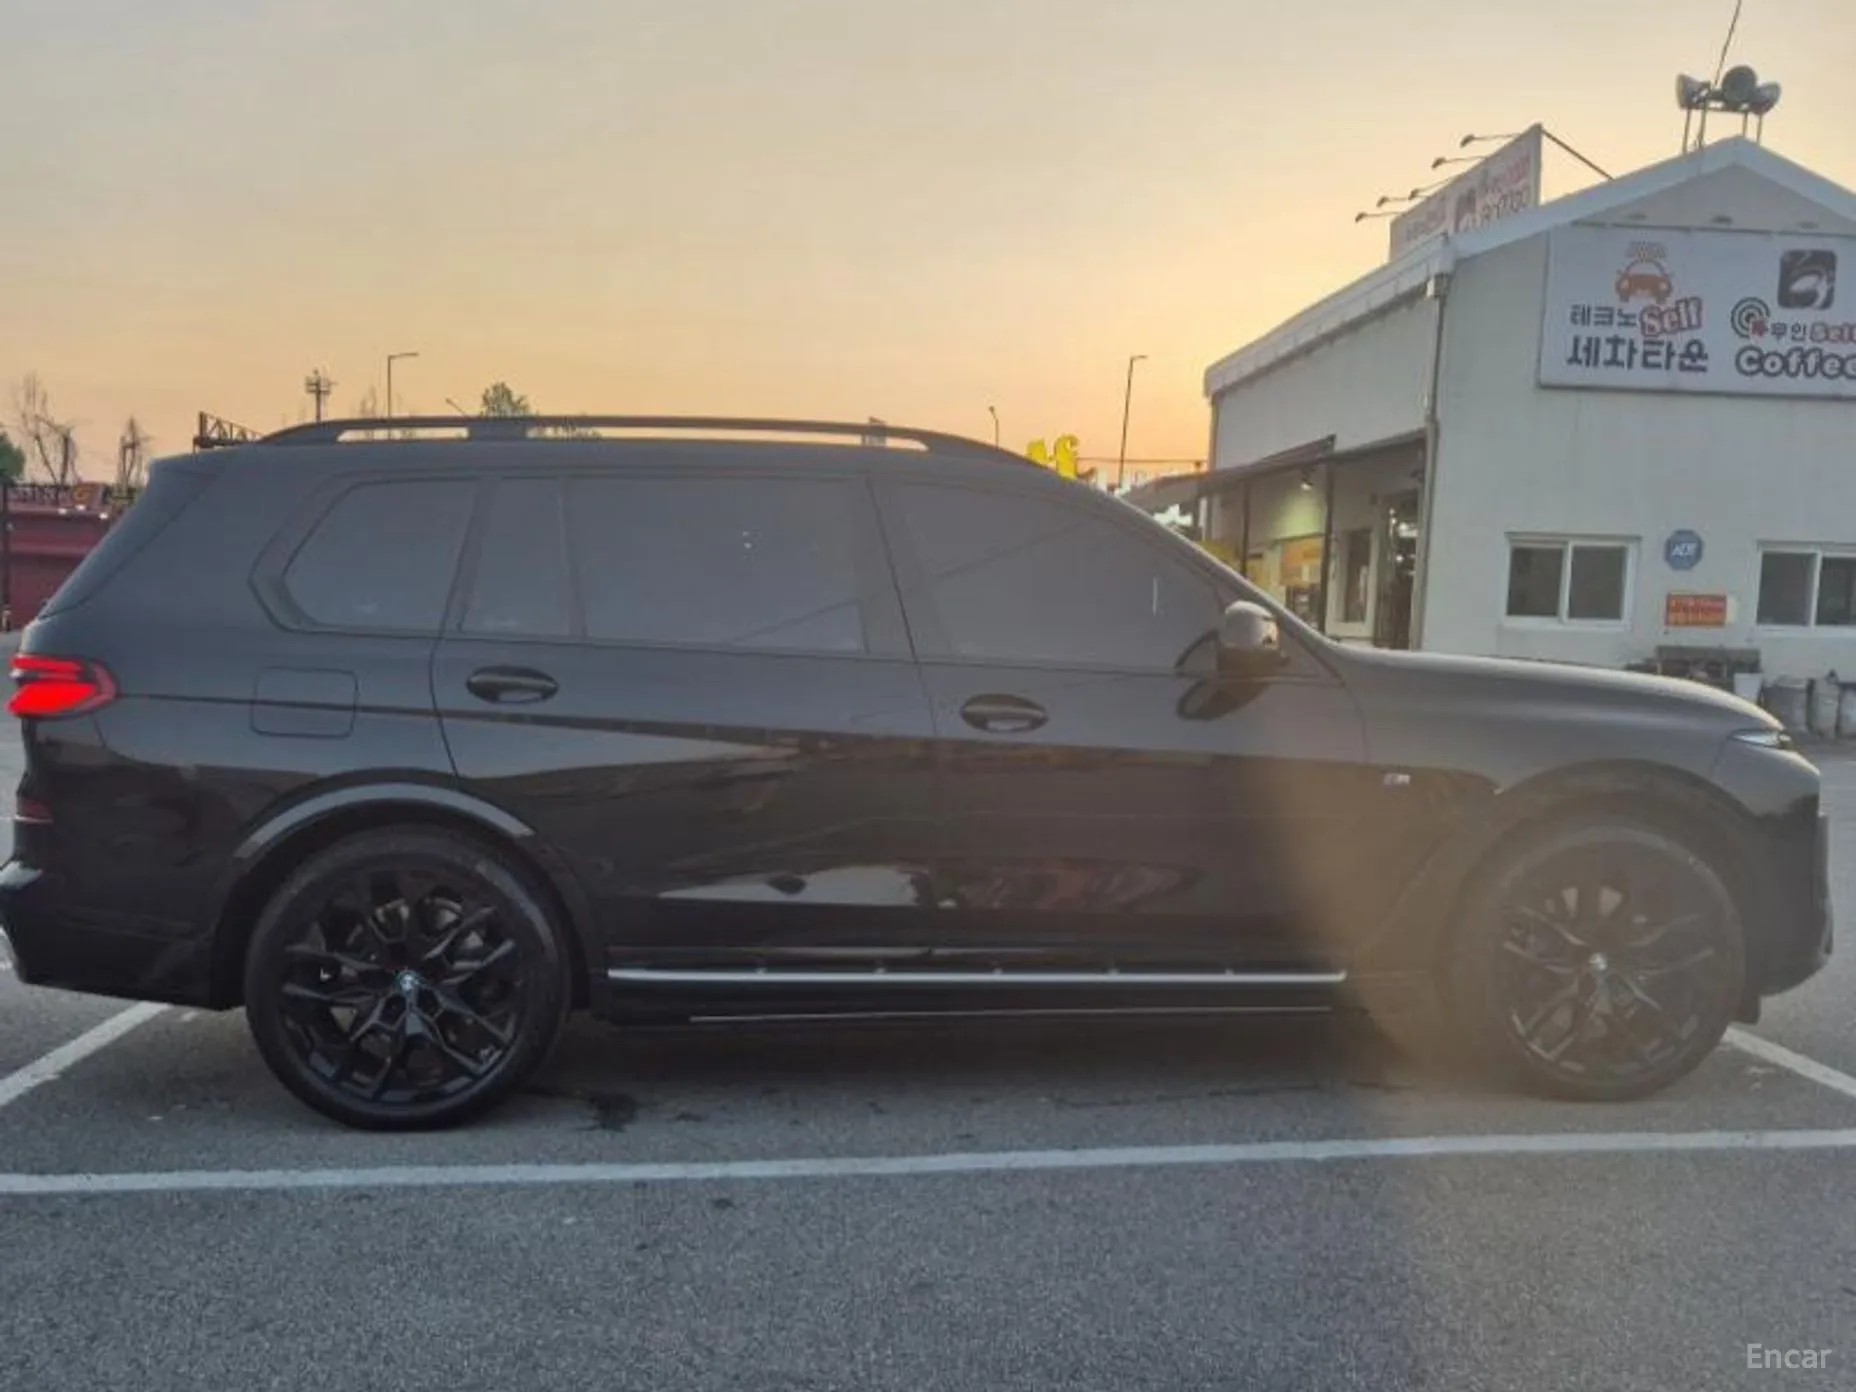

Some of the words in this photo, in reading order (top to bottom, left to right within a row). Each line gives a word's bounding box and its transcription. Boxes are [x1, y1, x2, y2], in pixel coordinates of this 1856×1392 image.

[1569, 303, 1638, 328] 테크노
[1639, 296, 1704, 337] Self
[1770, 321, 1807, 343] 무인
[1565, 333, 1709, 373] 세차타운
